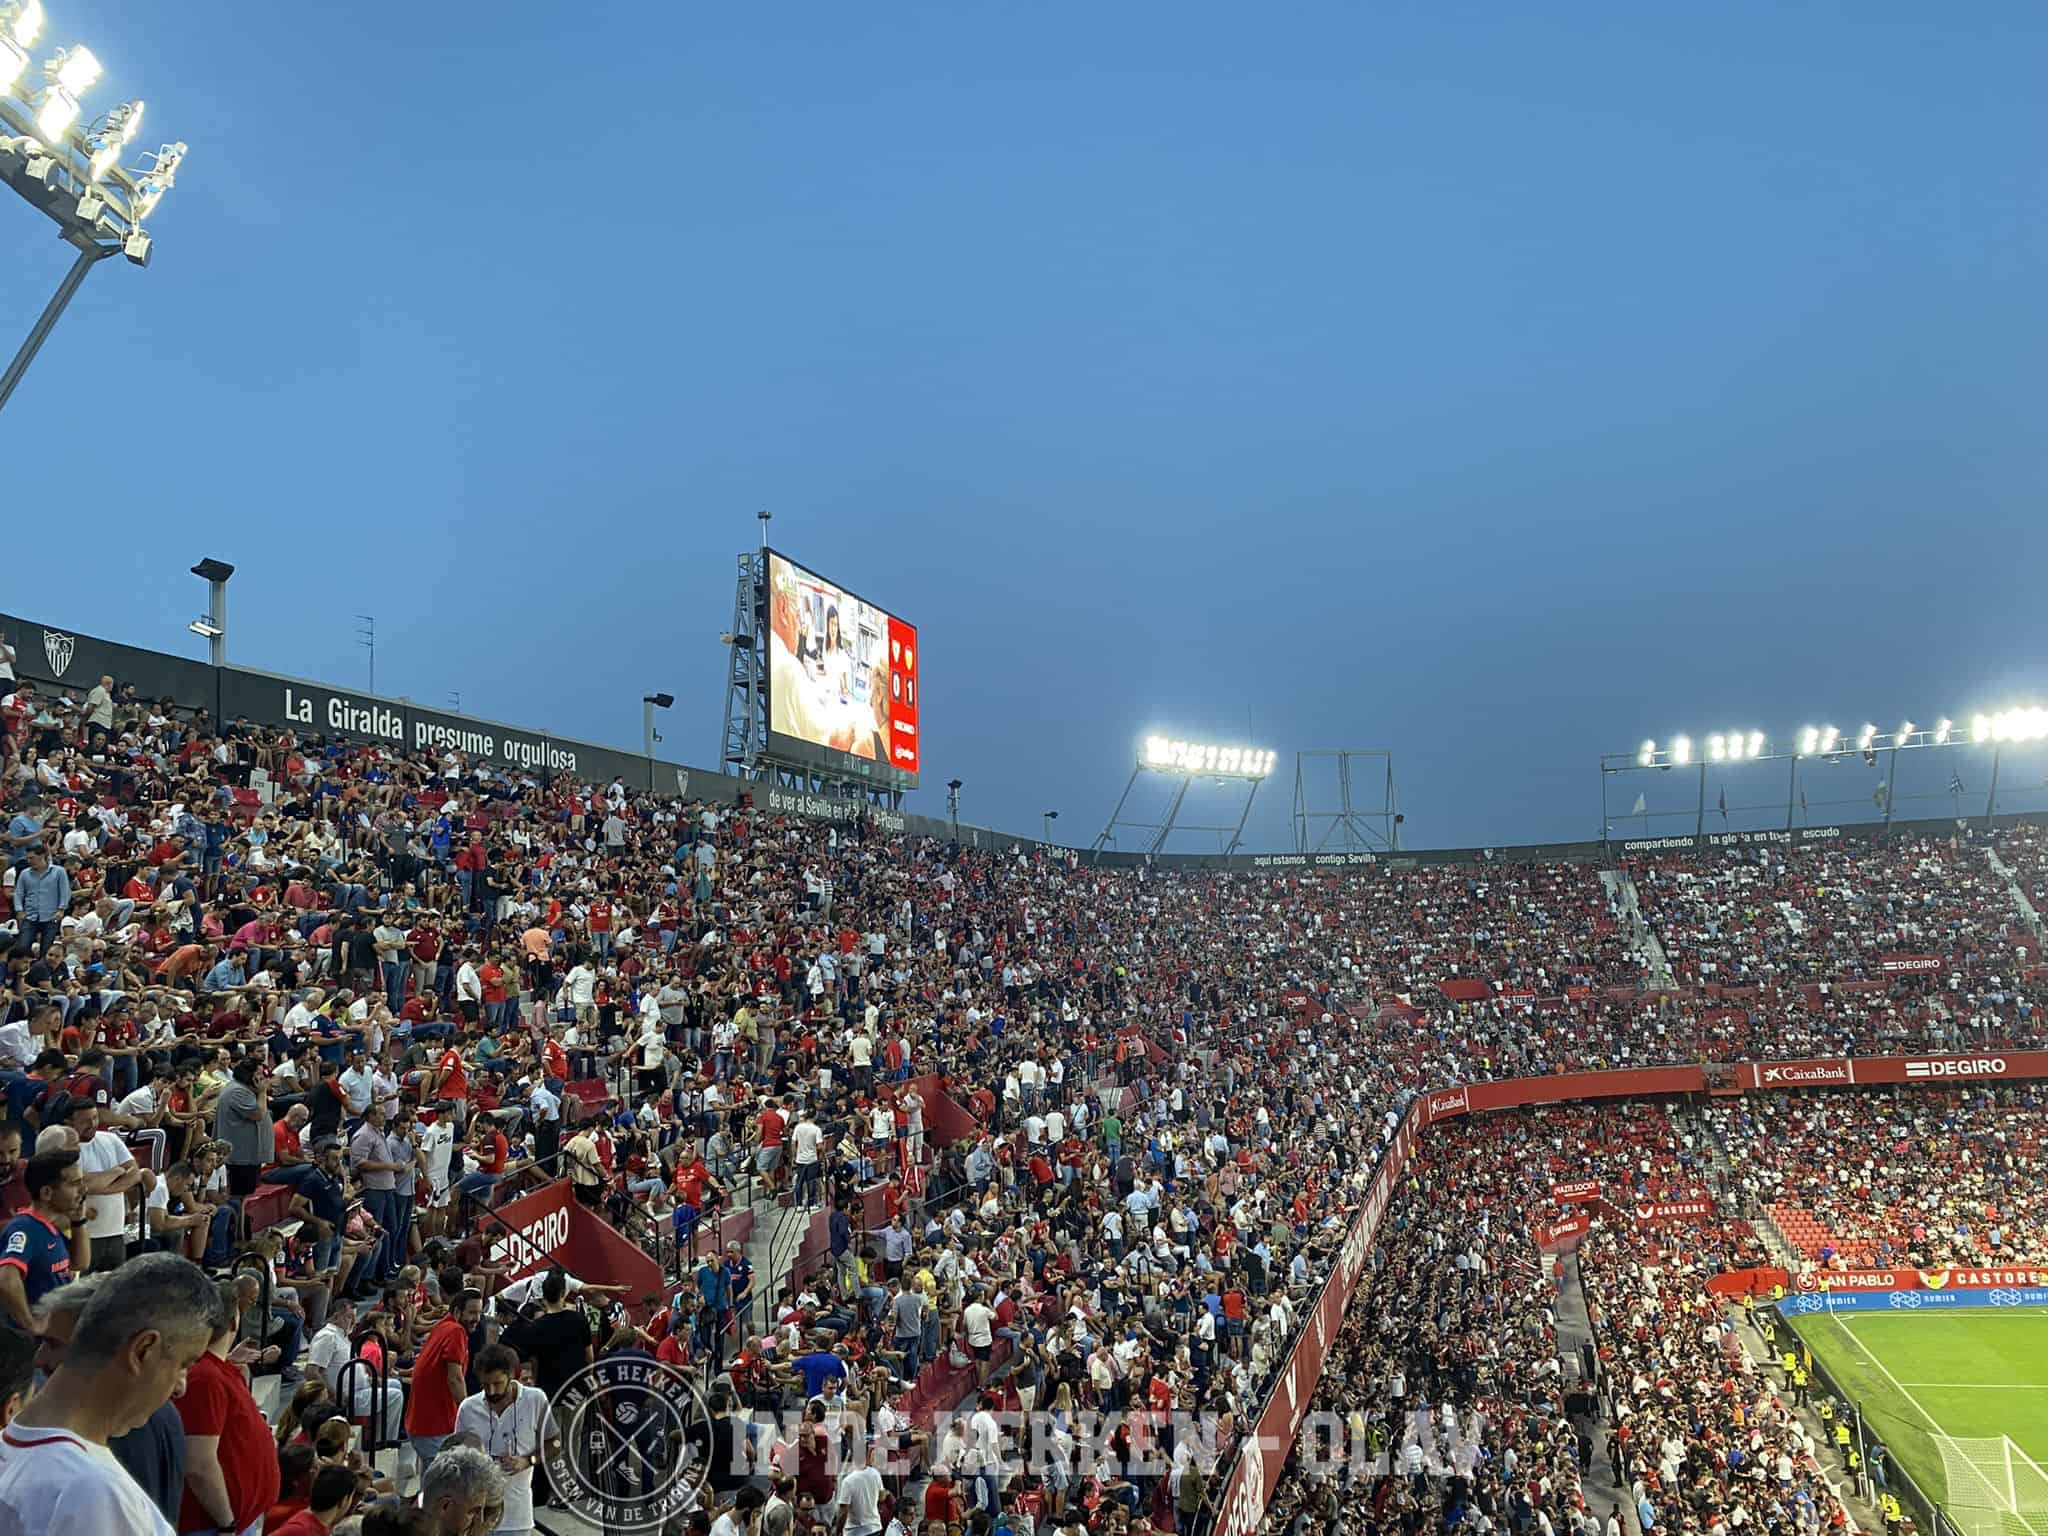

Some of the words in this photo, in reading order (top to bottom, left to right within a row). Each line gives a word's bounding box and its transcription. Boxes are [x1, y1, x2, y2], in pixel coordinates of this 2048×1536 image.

[285, 688, 313, 723] La
[328, 697, 403, 740] Giralda
[415, 719, 494, 757] presume
[503, 738, 577, 772] orgullosa
[806, 796, 832, 817] Sevilla
[1624, 837, 1694, 851] compartiendo
[1754, 832, 1767, 842] en
[1803, 826, 1840, 839] escudo
[1273, 856, 1306, 865] estamos
[1315, 855, 1346, 866] contigo
[1349, 853, 1376, 864] Sevilla
[1898, 959, 1941, 970] DEGIRO
[1782, 1067, 1845, 1080] CaixaBank
[1931, 1059, 2006, 1076] DEGIRO
[1656, 1204, 1706, 1216] CASTORE
[509, 1206, 569, 1276] DEGIRO
[1849, 1274, 1895, 1286] PABLO
[1957, 1271, 2038, 1284] CASTORE
